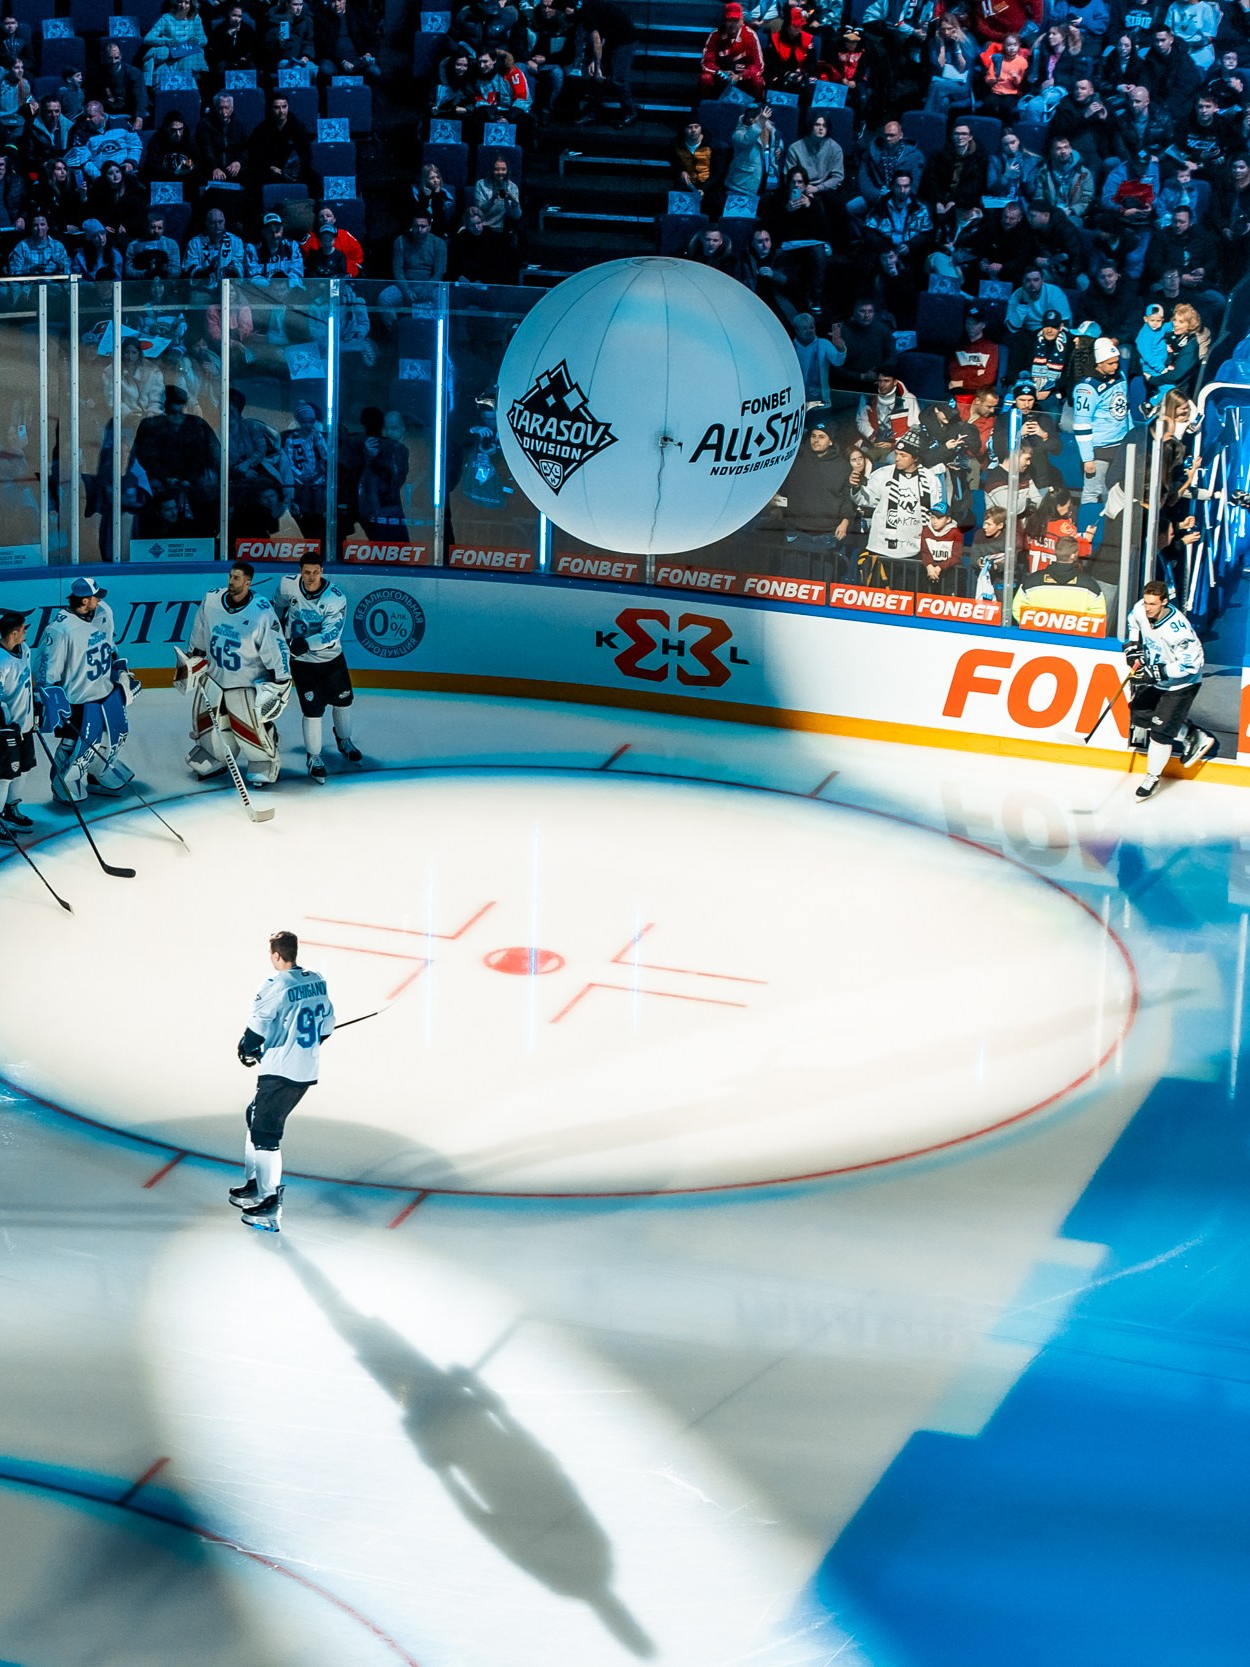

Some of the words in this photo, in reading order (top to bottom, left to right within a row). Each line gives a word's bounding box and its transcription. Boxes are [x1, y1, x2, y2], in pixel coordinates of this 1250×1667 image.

[741, 386, 791, 416] FONBET
[1076, 395, 1090, 412] 54
[513, 402, 606, 446] TARASOV
[523, 436, 582, 461] DIVISION
[710, 454, 781, 476] NOVOSIBIRSK
[237, 542, 319, 558] FONBET
[344, 544, 426, 562] FONBET
[450, 549, 531, 569] FONBET
[558, 557, 637, 579] FONBET
[657, 567, 736, 591] FONBET
[744, 577, 824, 601] FONBET
[831, 588, 912, 612] FONBET
[355, 590, 424, 624] БЕЗАЛКОГОЛЬНАЯ
[918, 598, 999, 621] FONBET
[1021, 609, 1104, 634] FONBET
[1169, 619, 1187, 633] 94
[210, 635, 241, 672] 45
[361, 637, 418, 658] ПРОДУКЦИЯ
[86, 642, 113, 682] 59
